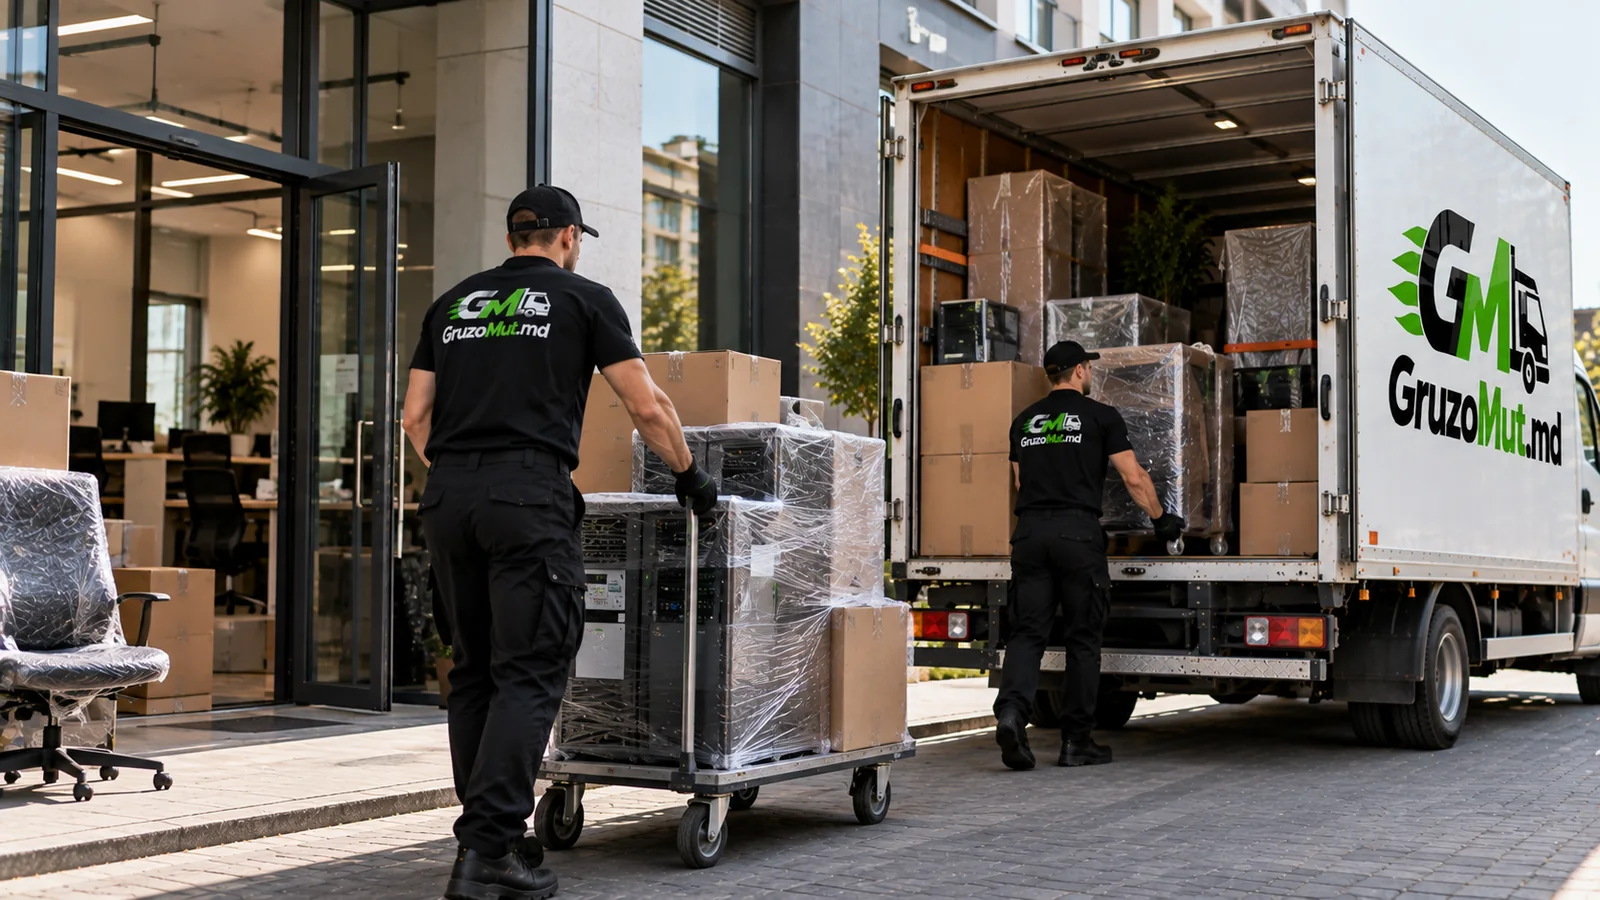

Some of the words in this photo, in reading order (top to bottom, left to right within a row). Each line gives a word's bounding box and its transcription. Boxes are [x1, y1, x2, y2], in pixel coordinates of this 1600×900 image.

[458, 288, 526, 320] GM
[1418, 209, 1511, 374] GM
[442, 321, 551, 344] GruzoMut.md
[1029, 412, 1066, 434] GM
[1388, 354, 1562, 467] GruzoMut.md
[1020, 433, 1082, 448] GruzoMut.md
